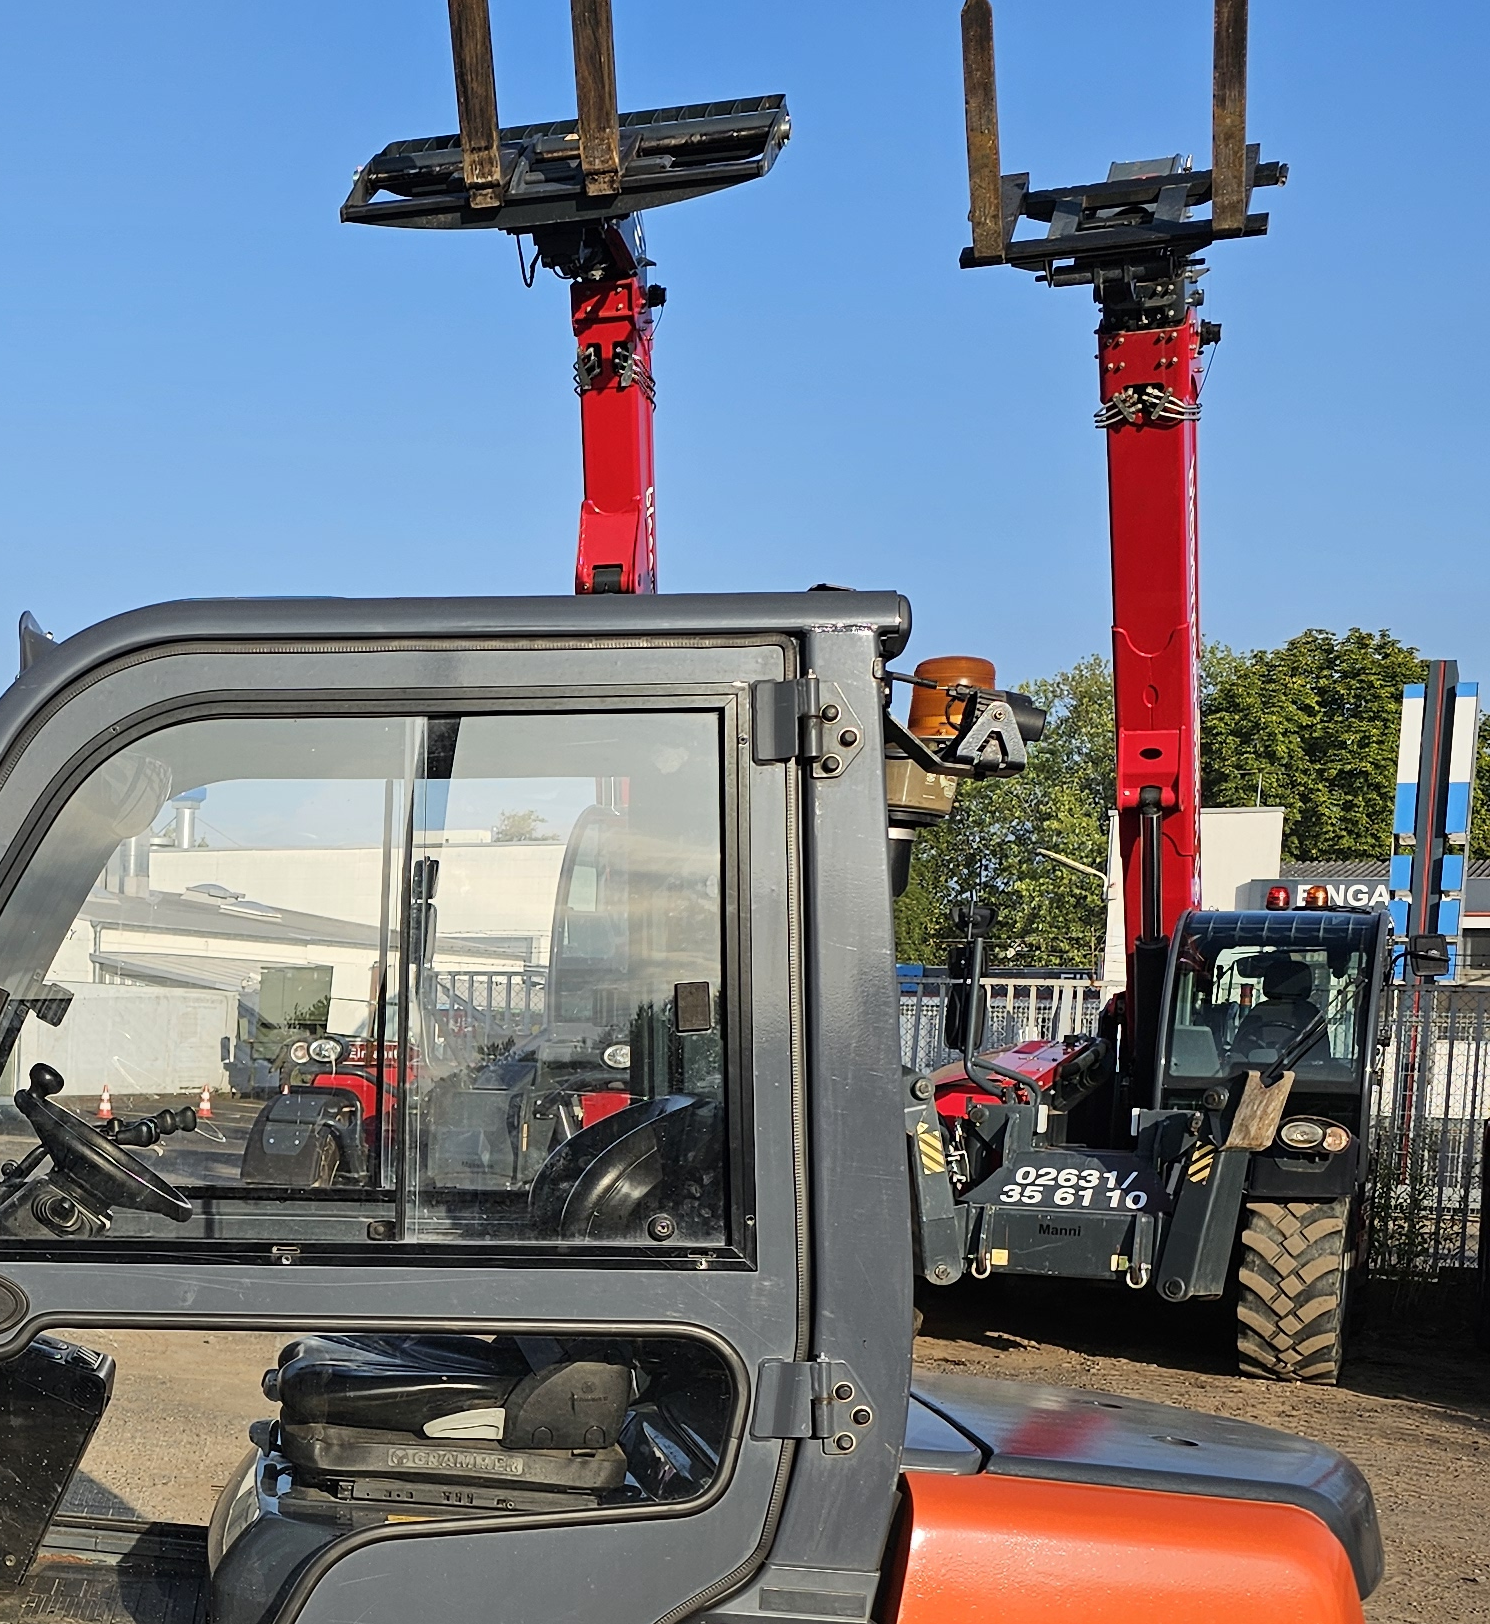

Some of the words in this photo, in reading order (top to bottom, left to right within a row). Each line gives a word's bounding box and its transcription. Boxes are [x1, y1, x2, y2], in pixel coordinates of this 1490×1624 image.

[1297, 884, 1390, 906] ENGA
[1015, 1166, 1139, 1189] 02631/
[999, 1184, 1044, 1204] 35
[1053, 1187, 1094, 1207] 61
[1105, 1189, 1148, 1209] 10
[1038, 1224, 1081, 1237] Manni
[413, 1449, 522, 1475] GRAMMER
